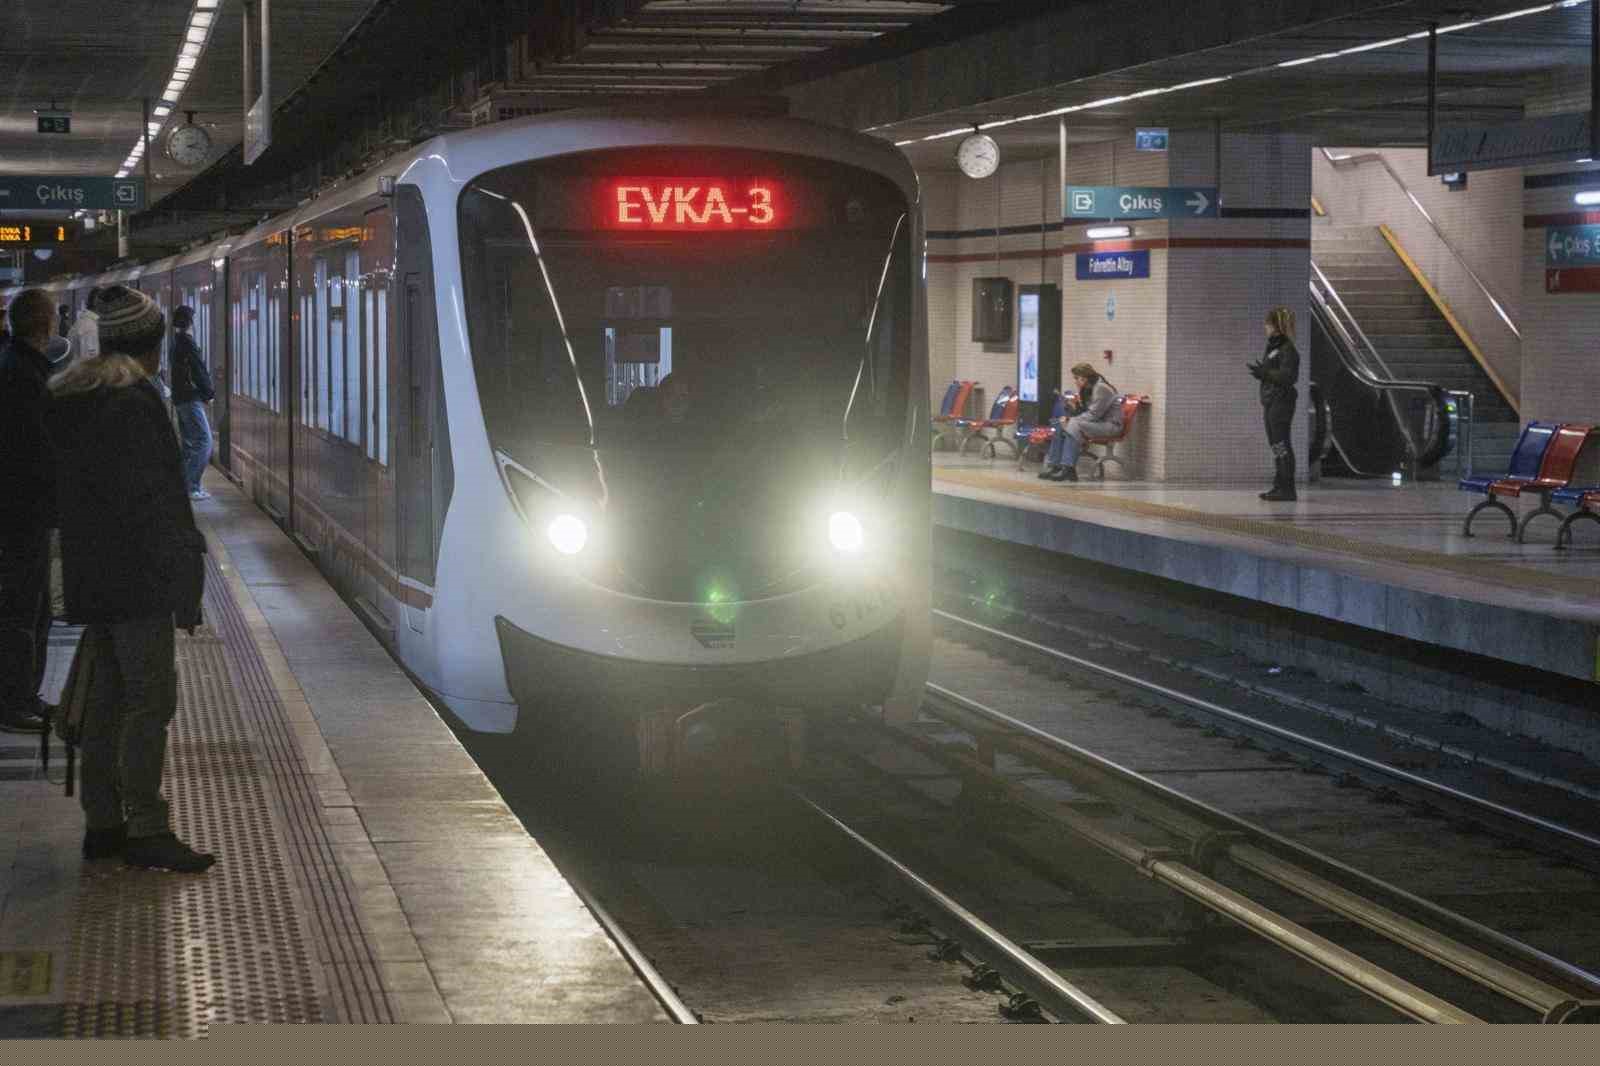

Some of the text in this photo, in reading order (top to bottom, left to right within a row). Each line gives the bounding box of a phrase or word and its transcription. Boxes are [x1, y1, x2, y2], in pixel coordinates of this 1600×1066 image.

[36, 185, 84, 204] Çıkış
[1119, 194, 1162, 212] Çıkış
[616, 186, 775, 224] EVKA-3
[1117, 257, 1134, 275] Altay
